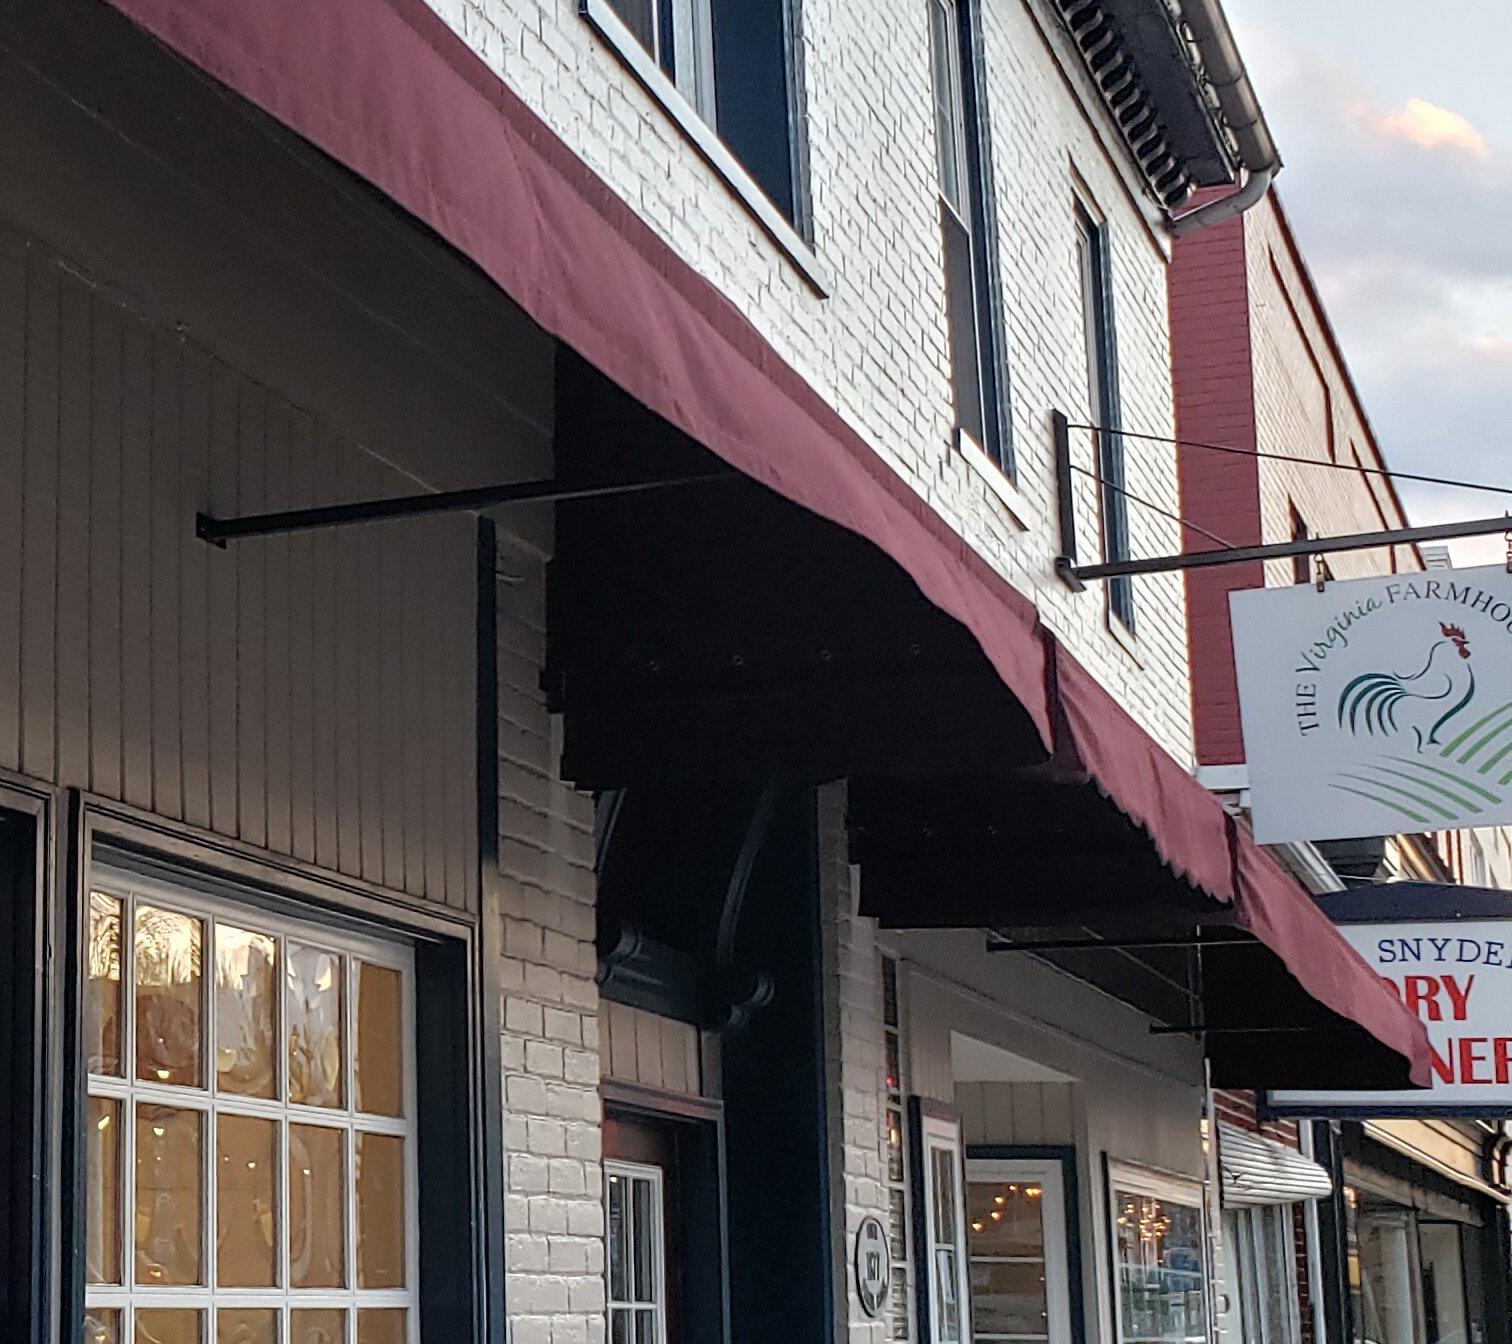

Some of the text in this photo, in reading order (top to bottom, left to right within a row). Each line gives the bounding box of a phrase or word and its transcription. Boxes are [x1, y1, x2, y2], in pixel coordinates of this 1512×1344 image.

[1295, 597, 1383, 673] Virginia
[1295, 682, 1320, 737] THE
[1378, 938, 1512, 969] SNYDE
